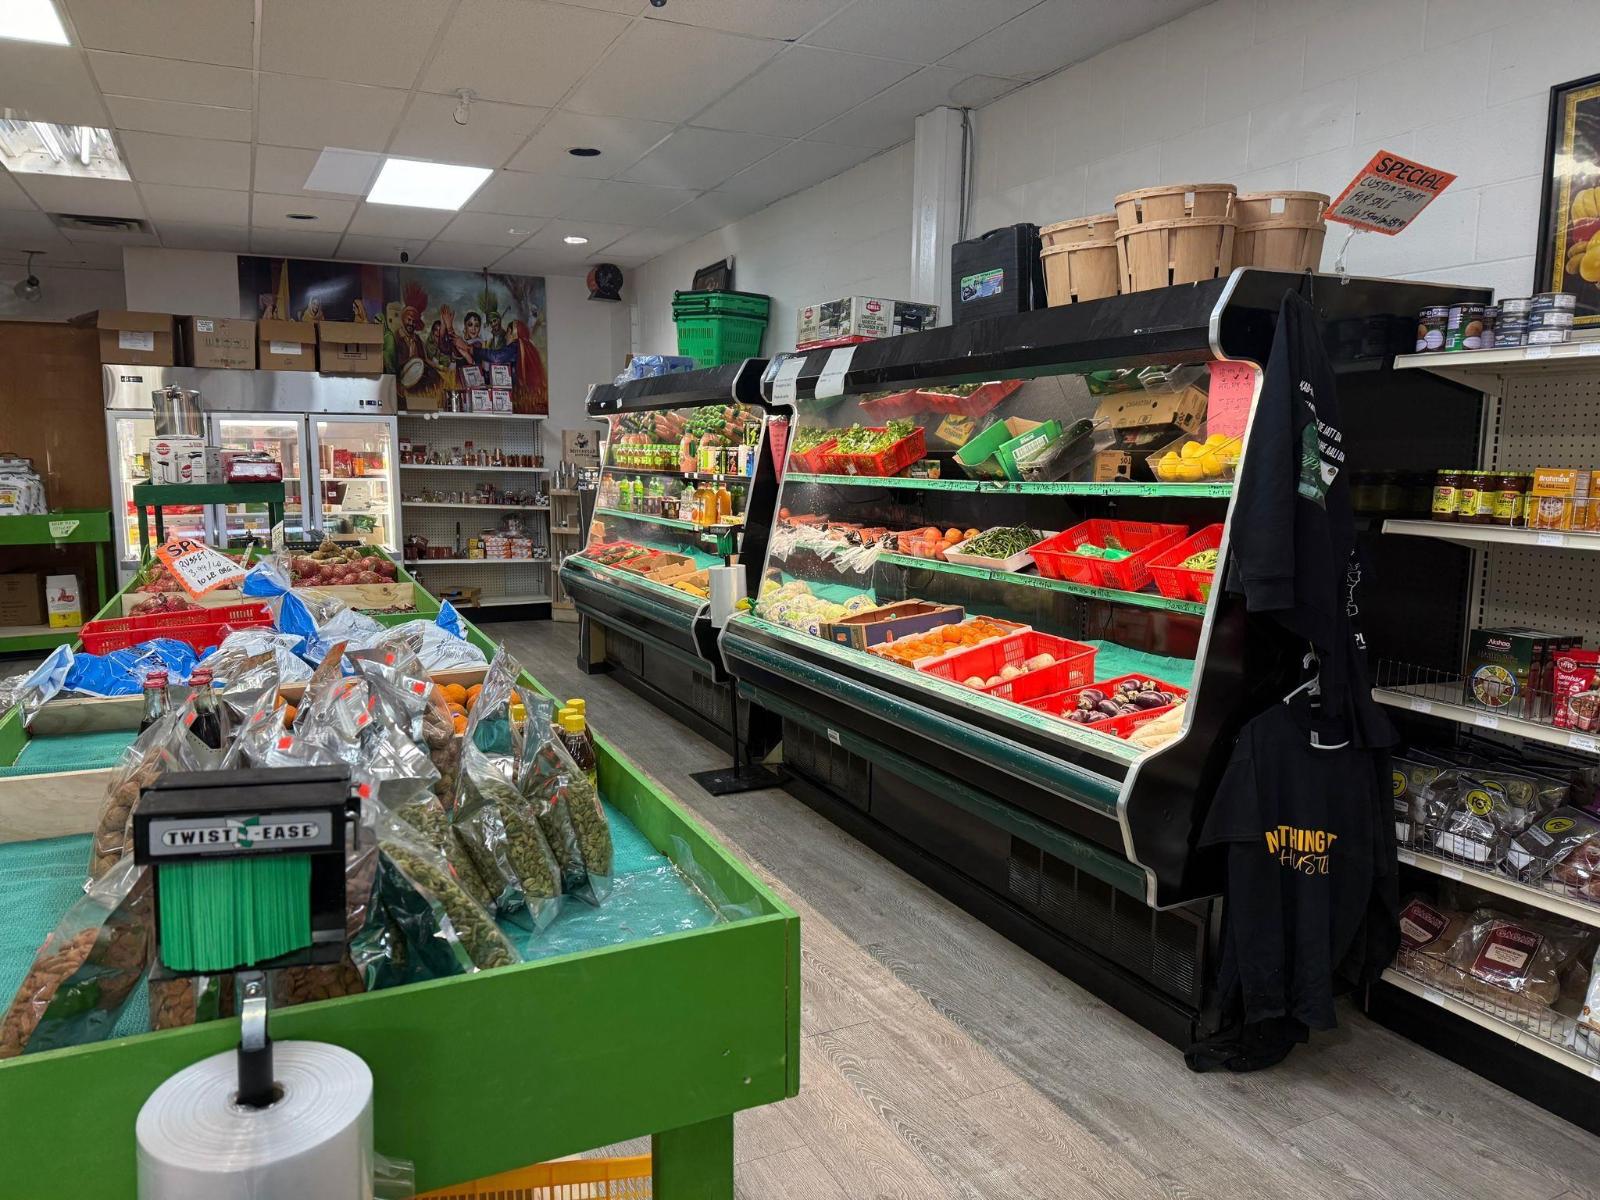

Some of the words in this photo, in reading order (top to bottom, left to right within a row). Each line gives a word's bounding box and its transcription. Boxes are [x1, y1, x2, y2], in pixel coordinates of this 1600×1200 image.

[1375, 157, 1445, 191] SPECIAL
[1367, 195, 1398, 210] SALE
[168, 829, 232, 845] TWIST
